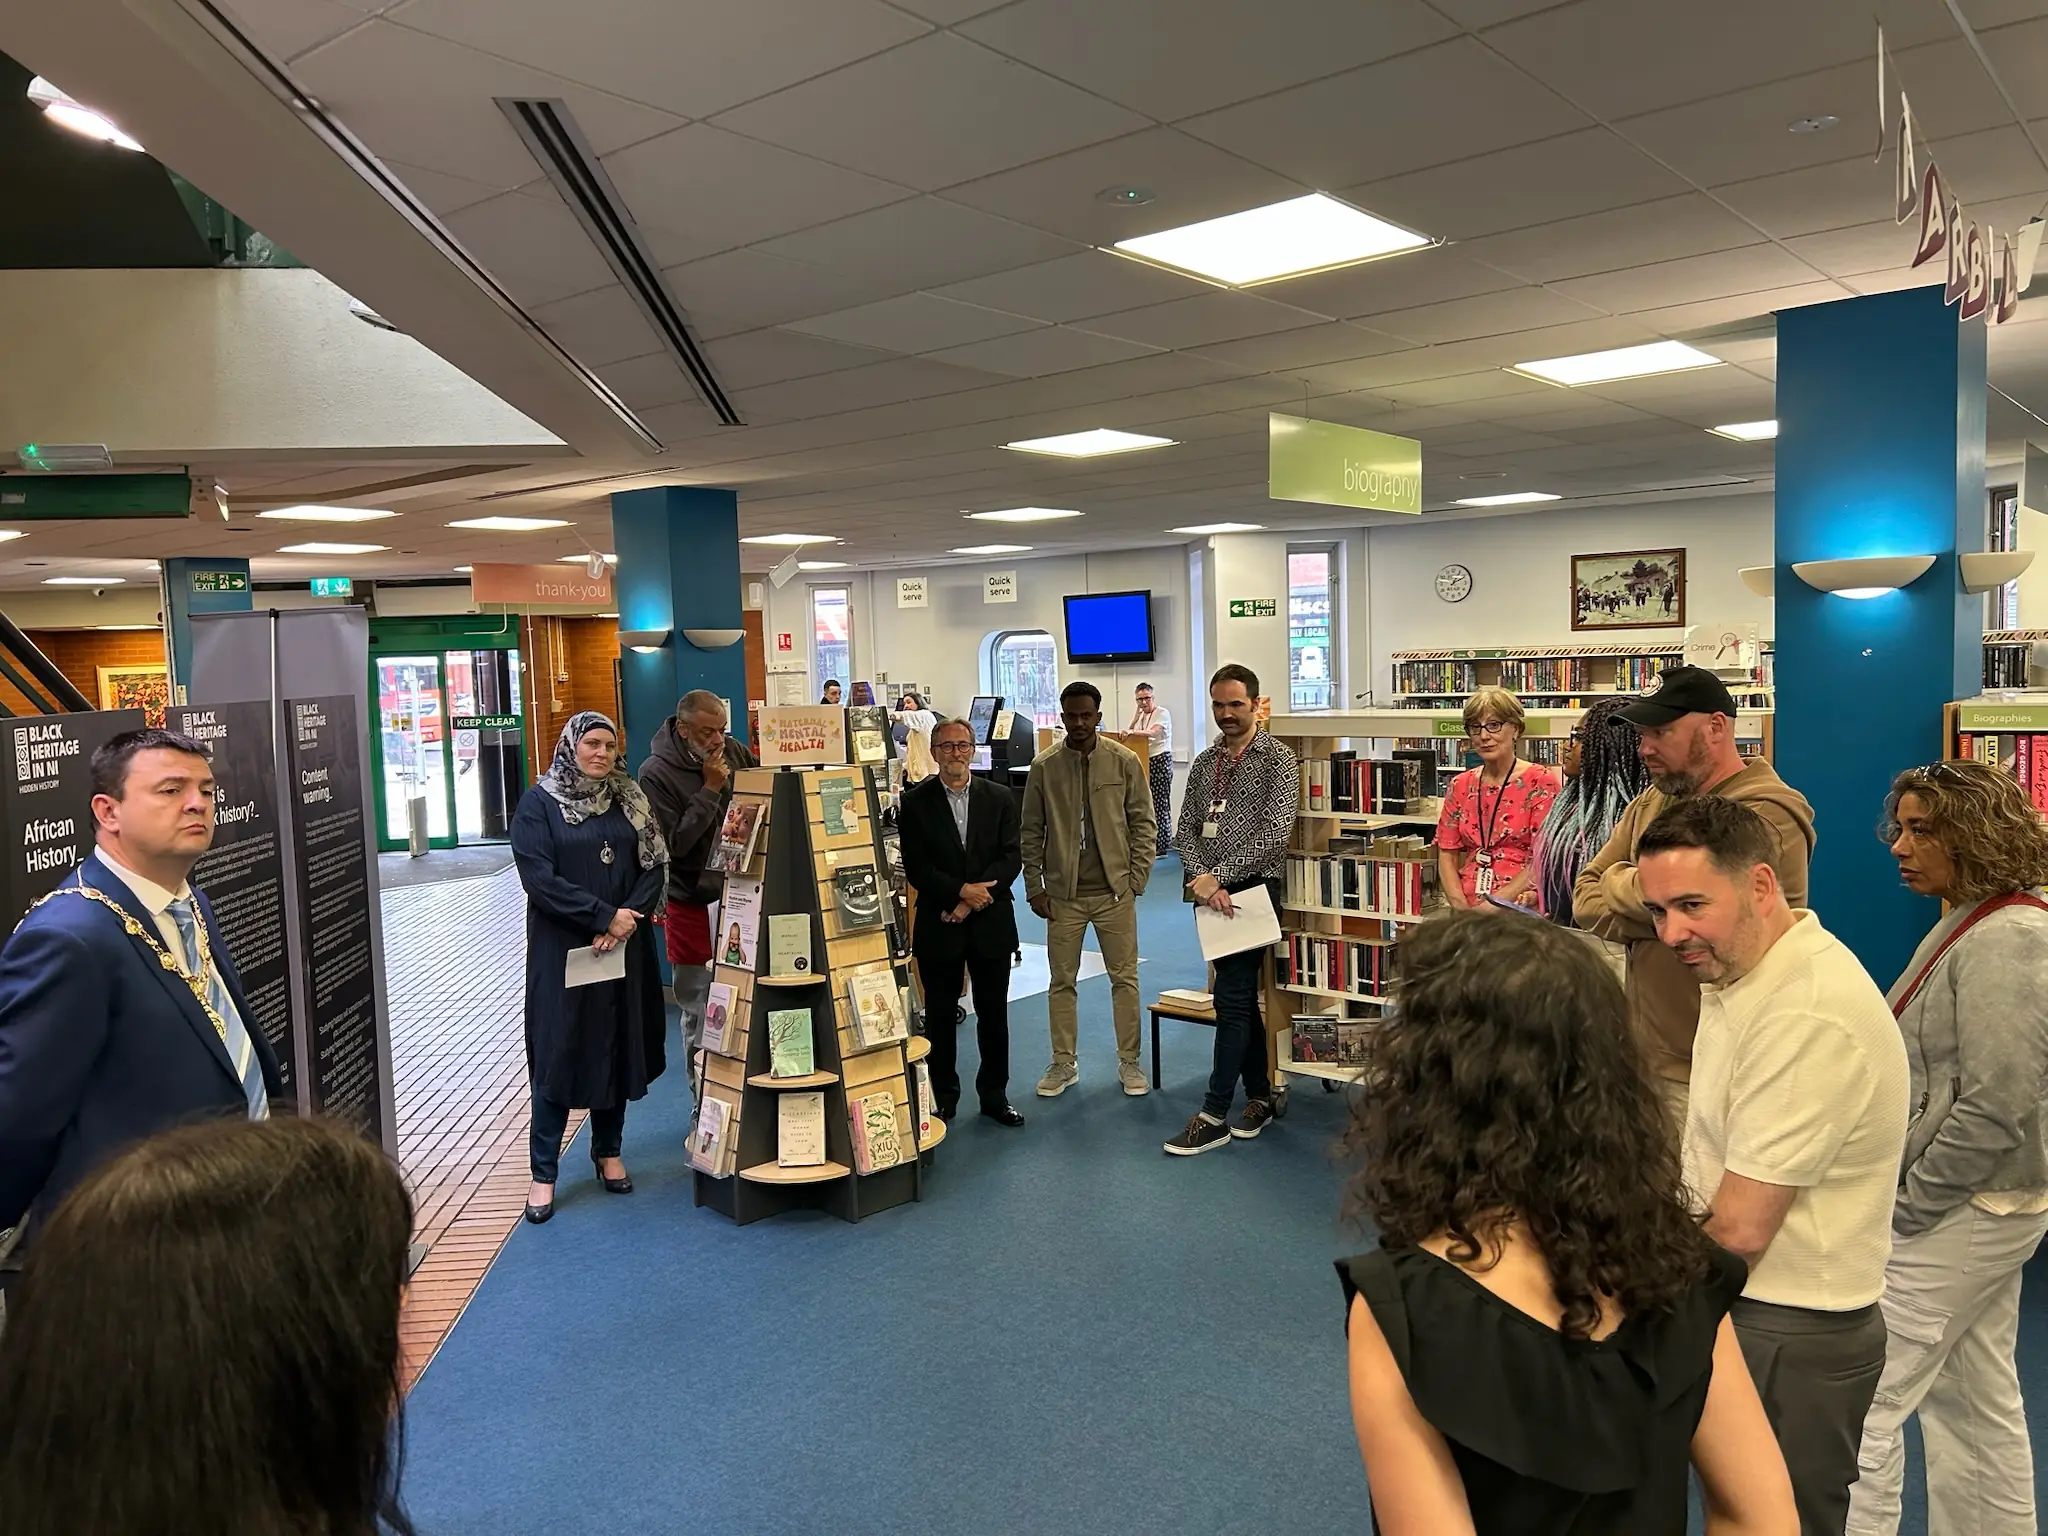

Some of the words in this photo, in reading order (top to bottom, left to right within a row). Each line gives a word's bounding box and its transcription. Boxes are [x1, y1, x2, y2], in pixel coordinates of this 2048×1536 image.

[195, 573, 215, 581] FIRE
[989, 577, 1010, 585] Quick
[536, 581, 606, 600] thank-you
[902, 583, 922, 591] Quick
[1255, 608, 1274, 616] EXIT
[1691, 644, 1716, 652] Crime
[303, 704, 318, 714] BLACK
[193, 712, 215, 725] BLACK
[304, 715, 326, 726] HERITAGE
[457, 718, 481, 727] KEEP
[485, 717, 516, 726] CLEAR
[780, 718, 827, 728] MATERNAL
[1973, 714, 2032, 723] Biographies
[29, 724, 63, 742] BLACK
[194, 725, 227, 739] HERITAGE
[305, 730, 311, 740] IN
[312, 728, 318, 738] NI
[780, 726, 826, 740] MENTAL
[30, 739, 79, 760] HERITAGE
[779, 738, 825, 752] HEALTH
[32, 762, 44, 778] IN
[47, 760, 59, 776] NI
[302, 767, 328, 785] Content
[19, 783, 39, 794] HIDDEN
[39, 780, 60, 791] HISTORY
[217, 786, 225, 802] is
[24, 818, 75, 846] African
[877, 1140, 893, 1153] XIU
[878, 1152, 895, 1161] YANG
